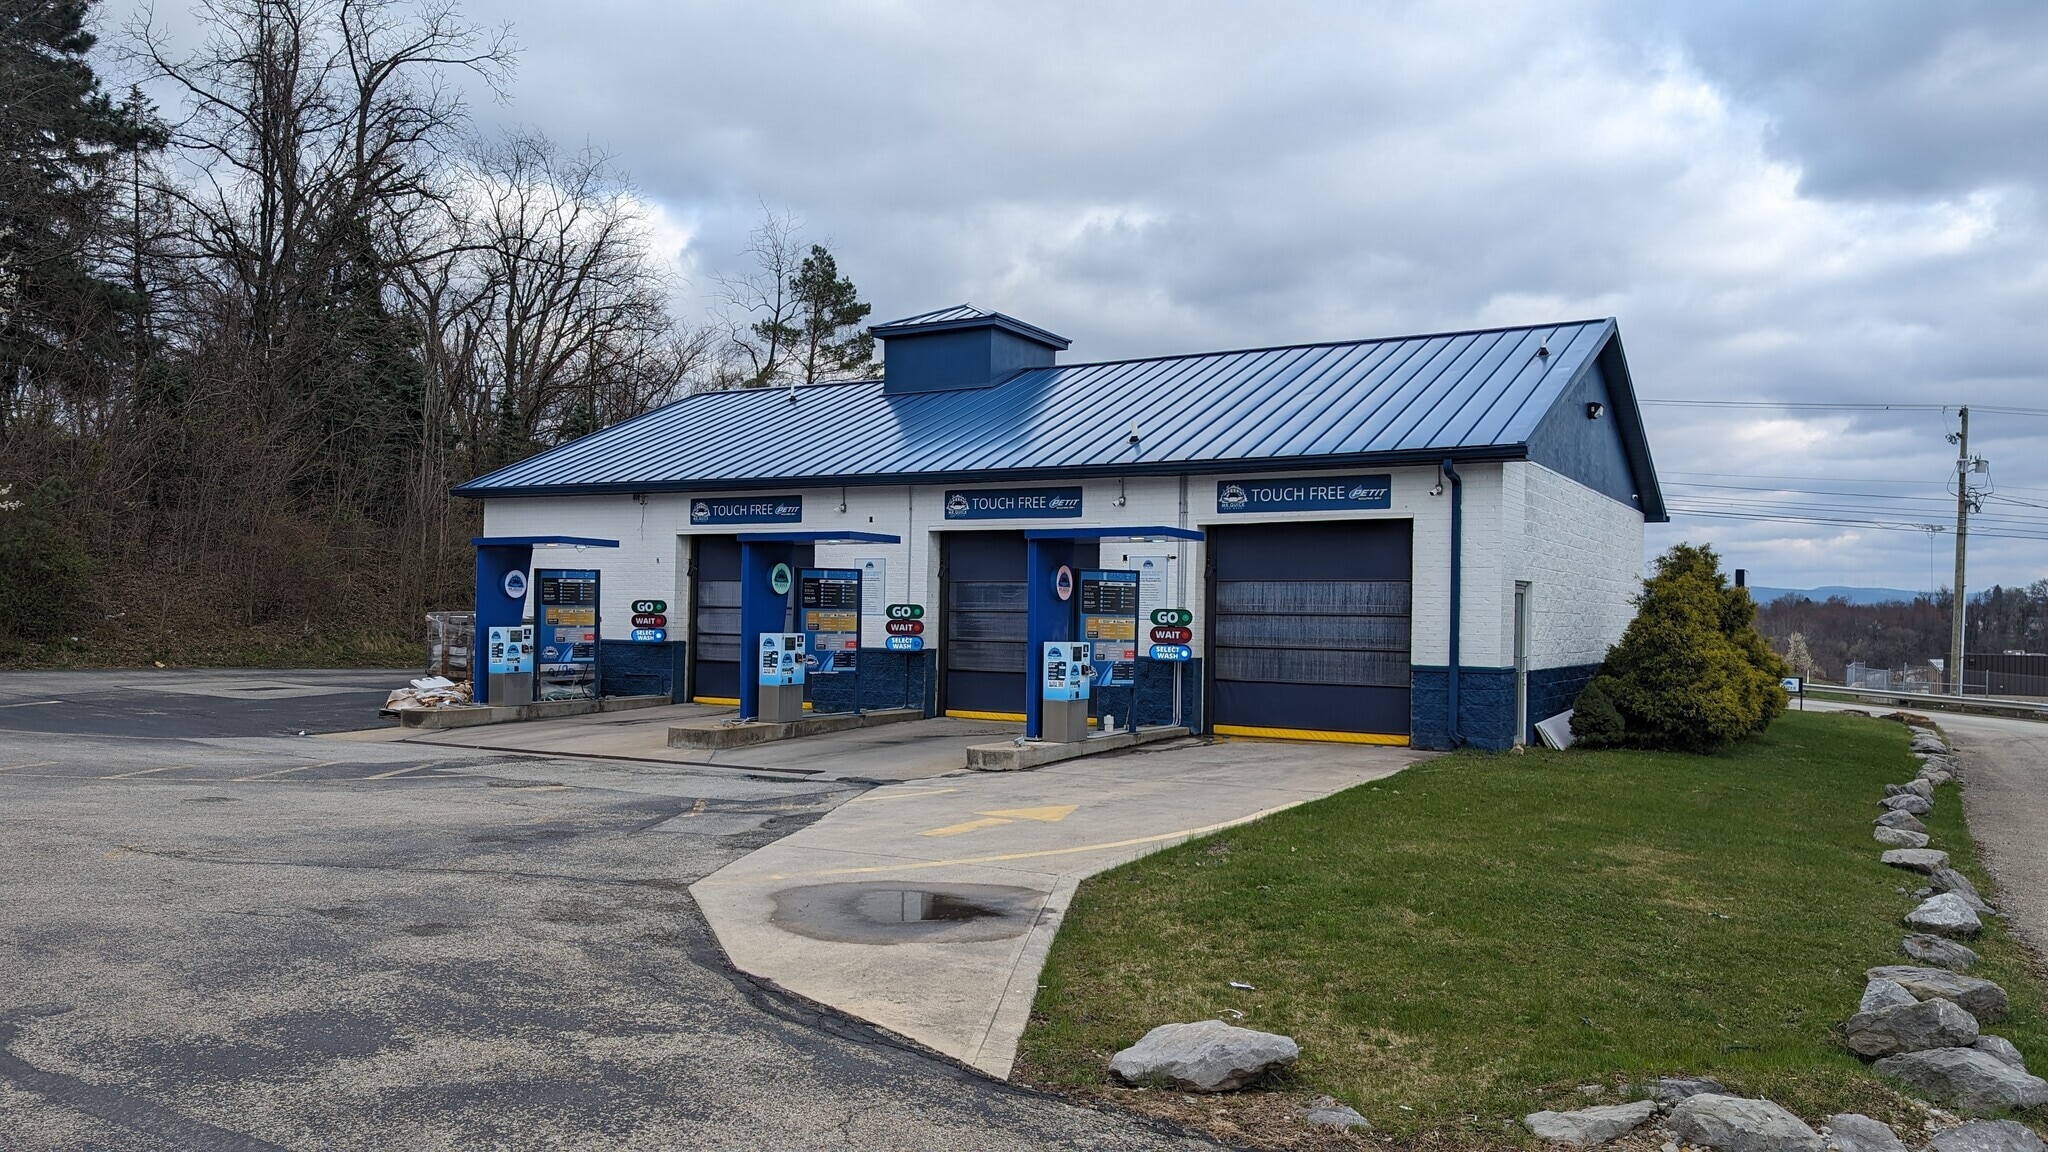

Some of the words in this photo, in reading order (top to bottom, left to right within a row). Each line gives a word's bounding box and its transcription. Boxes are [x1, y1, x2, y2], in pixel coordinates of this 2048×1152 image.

[1251, 488, 1304, 502] TOUCH
[1309, 486, 1345, 500] FREE
[1349, 487, 1388, 498] PETIT
[972, 497, 1015, 510] TOUCH
[1018, 496, 1047, 509] FREE
[1049, 498, 1080, 508] PETIT
[712, 505, 747, 516] TOUCH
[750, 504, 774, 515] FREE
[775, 505, 800, 514] PETIT
[637, 602, 654, 612] GO
[892, 606, 912, 618] GO
[635, 617, 656, 625] WAIT
[1157, 611, 1179, 624] GO
[1155, 631, 1181, 639] WAIT
